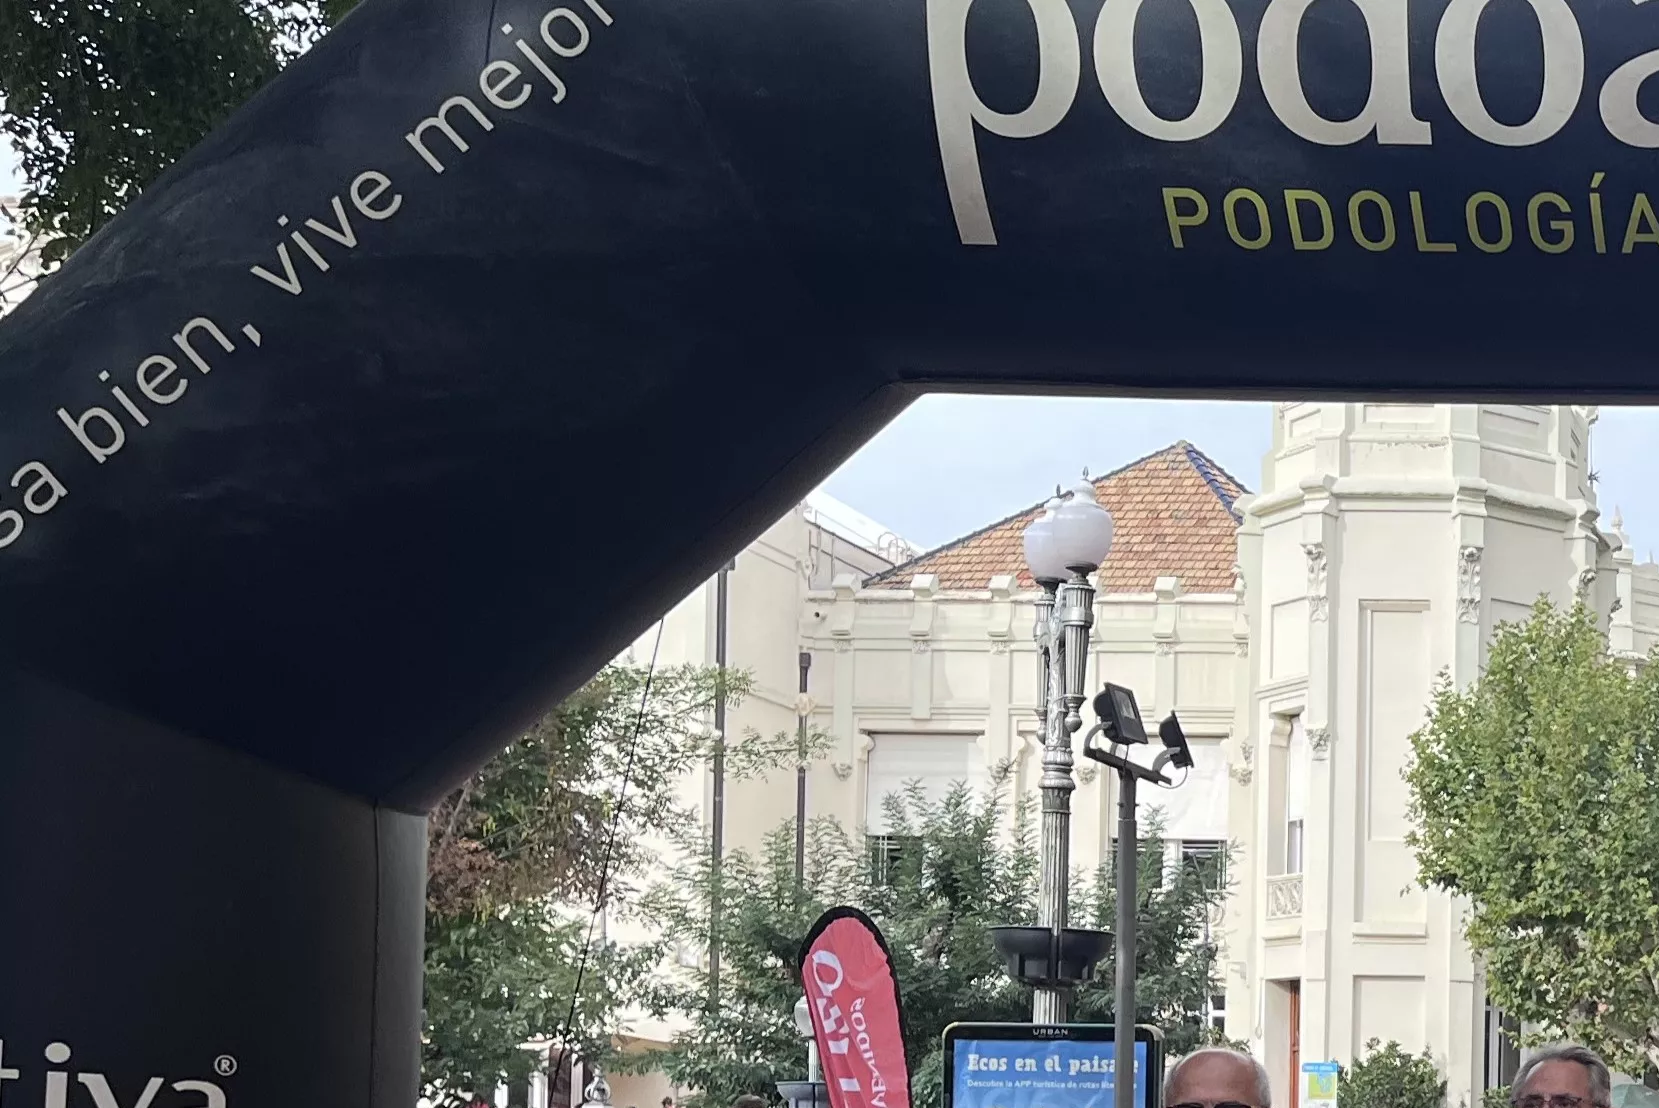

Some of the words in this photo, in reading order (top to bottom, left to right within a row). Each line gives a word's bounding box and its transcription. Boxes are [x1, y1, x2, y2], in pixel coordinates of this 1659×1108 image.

[57, 316, 262, 464] bien,
[250, 170, 403, 296] vive
[967, 1054, 1008, 1072] Ecos
[1015, 1057, 1037, 1072] en
[1045, 1055, 1060, 1072] el
[1069, 1055, 1138, 1076] paisae
